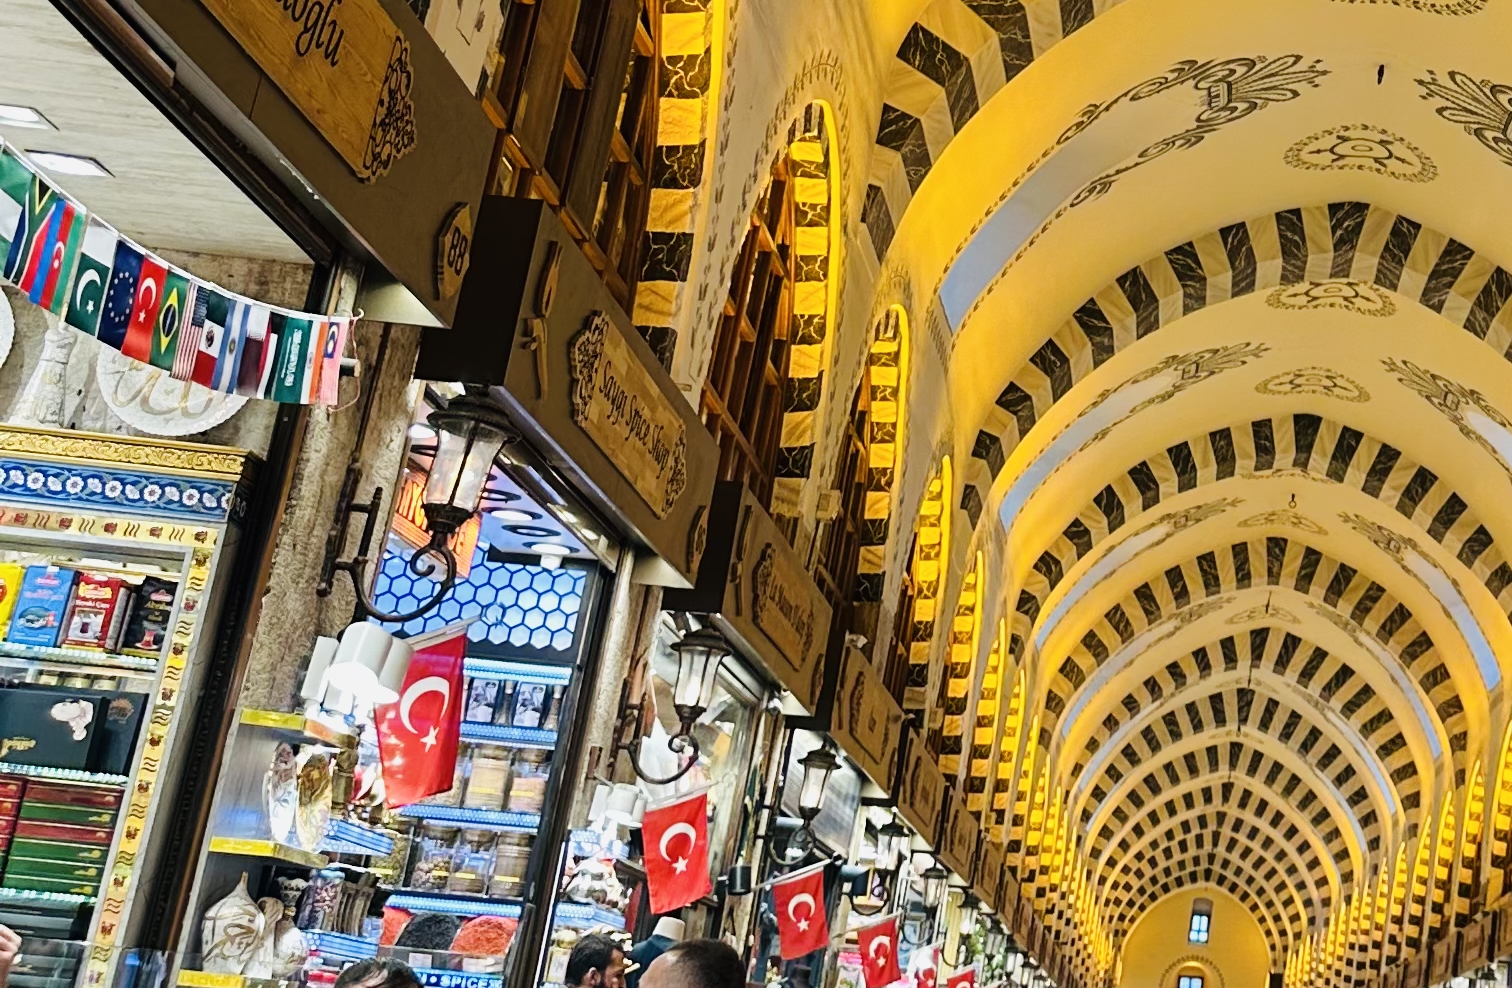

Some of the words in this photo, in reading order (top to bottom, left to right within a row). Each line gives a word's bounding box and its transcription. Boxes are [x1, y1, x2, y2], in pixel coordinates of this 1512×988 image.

[447, 226, 469, 276] 88
[599, 360, 628, 426] Saygı
[624, 394, 651, 447] Spice
[648, 424, 670, 480] Shop
